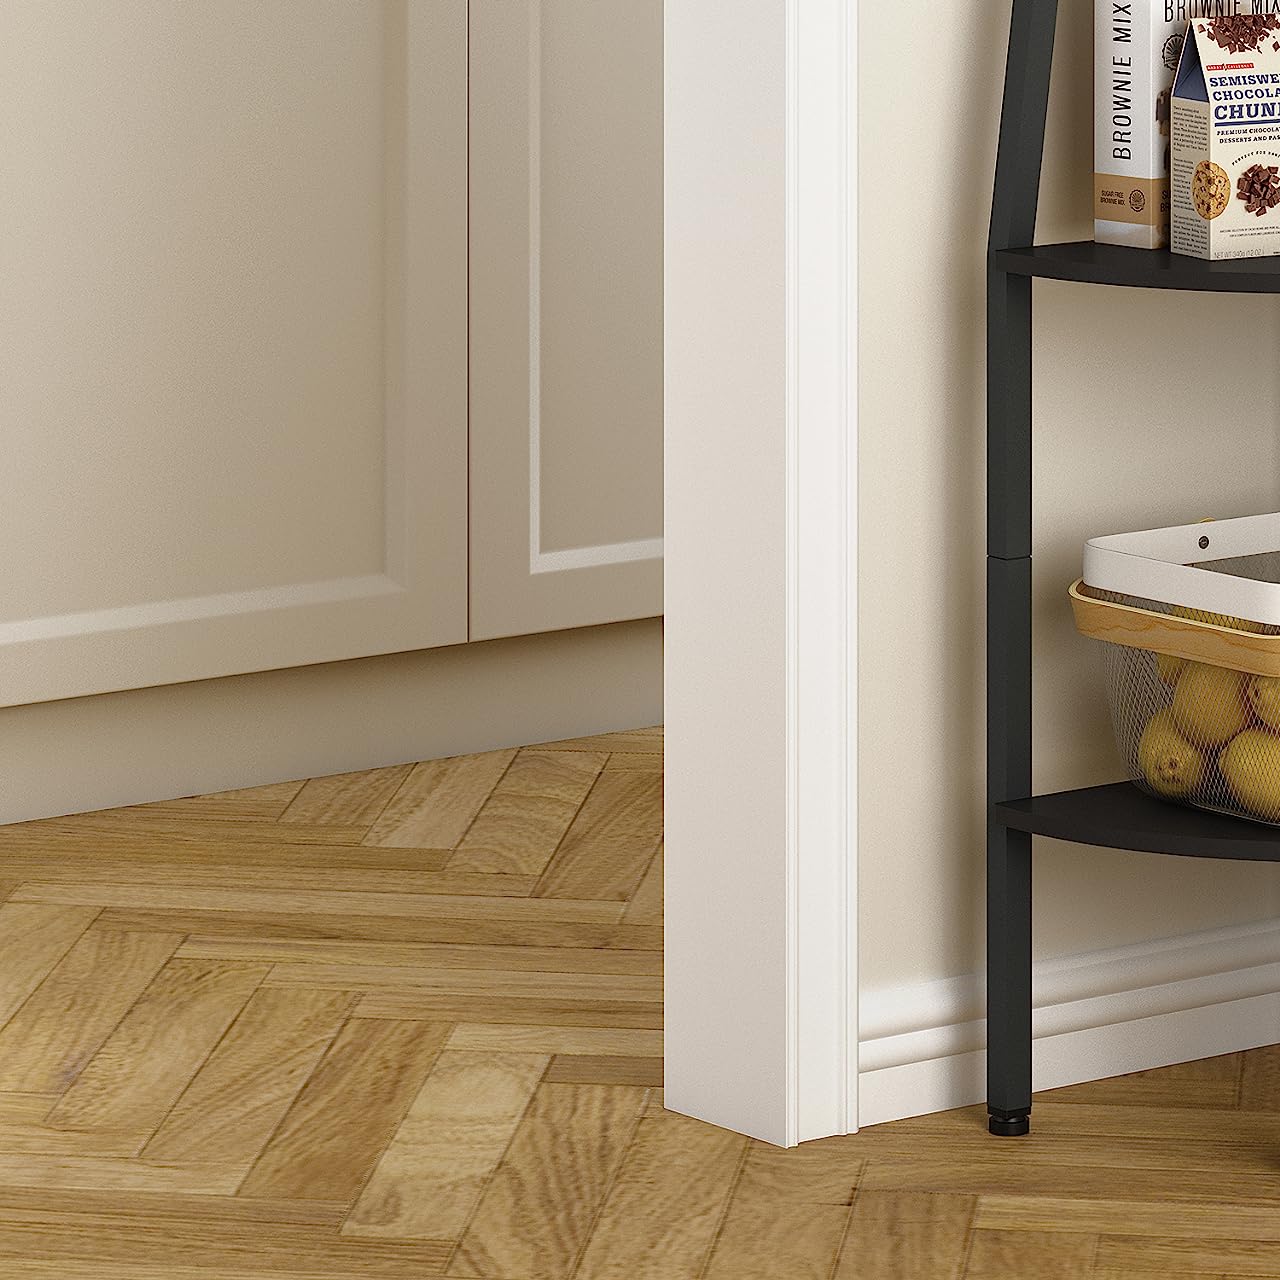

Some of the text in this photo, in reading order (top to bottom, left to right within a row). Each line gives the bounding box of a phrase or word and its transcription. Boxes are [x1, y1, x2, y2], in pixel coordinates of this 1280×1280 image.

[1112, 2, 1132, 160] BROWNIE MIX
[1216, 128, 1248, 136] PREMIUM
[1219, 136, 1252, 144] DESSERTS
